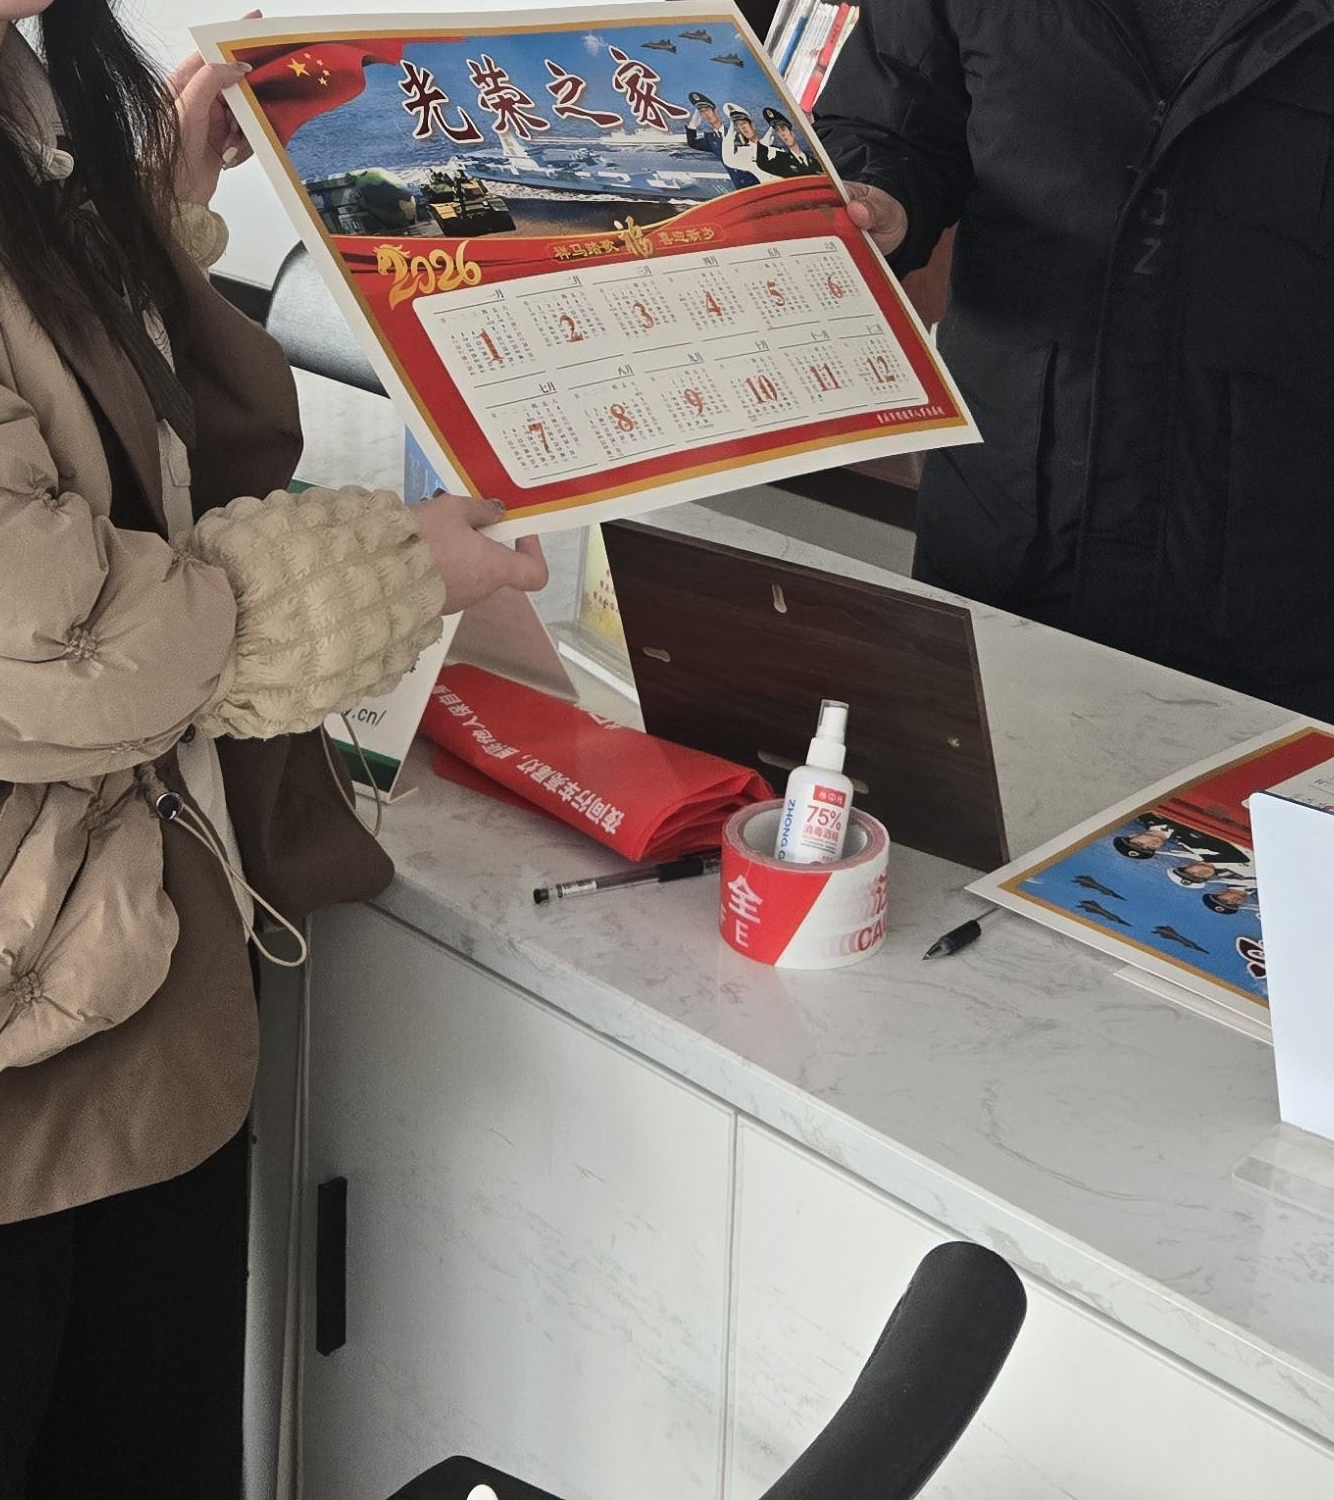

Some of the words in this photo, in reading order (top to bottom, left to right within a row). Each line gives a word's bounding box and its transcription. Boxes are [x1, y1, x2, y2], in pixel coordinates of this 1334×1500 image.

[398, 45, 691, 144] 光荣之家
[373, 238, 482, 310] 2026
[827, 275, 844, 299] 6
[704, 290, 723, 316] 4
[767, 281, 786, 306] 5
[559, 314, 584, 342] 2
[632, 300, 655, 329] 3
[479, 328, 505, 363] 1
[810, 363, 842, 392] 11
[867, 355, 896, 383] 12
[683, 389, 704, 417] 9
[745, 374, 778, 405] 10
[610, 403, 635, 433] 8
[527, 422, 550, 454] 7
[806, 804, 843, 831] 75%
[728, 874, 764, 924] 全
